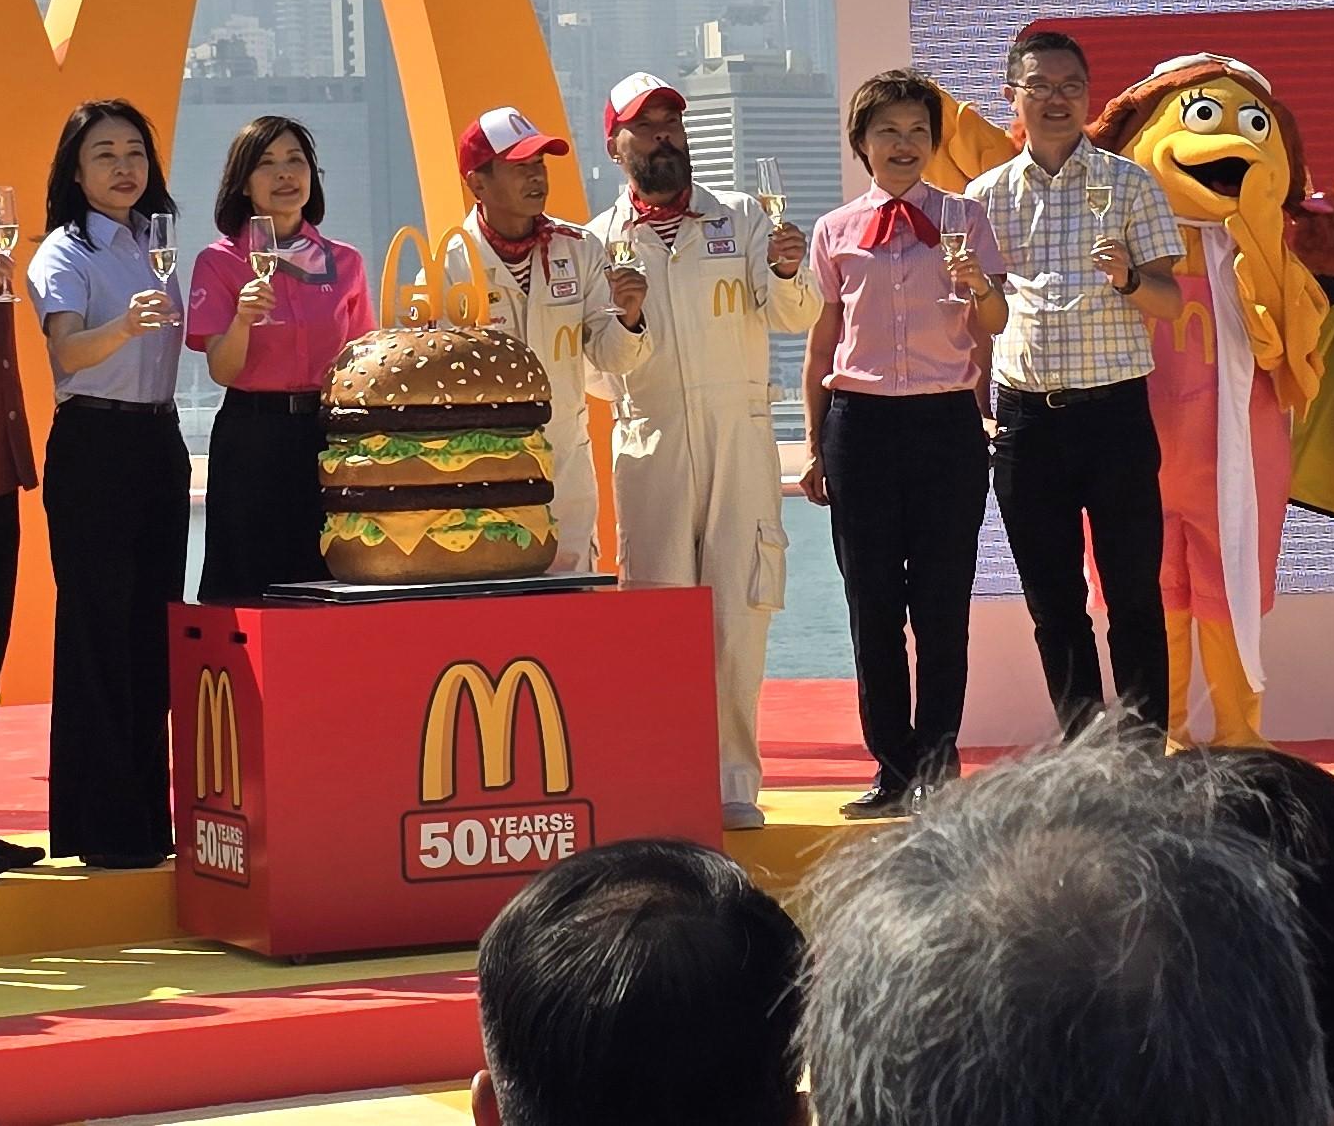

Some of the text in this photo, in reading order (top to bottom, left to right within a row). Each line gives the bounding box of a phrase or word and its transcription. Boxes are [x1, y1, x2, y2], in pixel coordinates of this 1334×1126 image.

[196, 819, 218, 866] 50
[217, 824, 240, 845] YEARS
[419, 813, 574, 868] 50 YEARS OF
